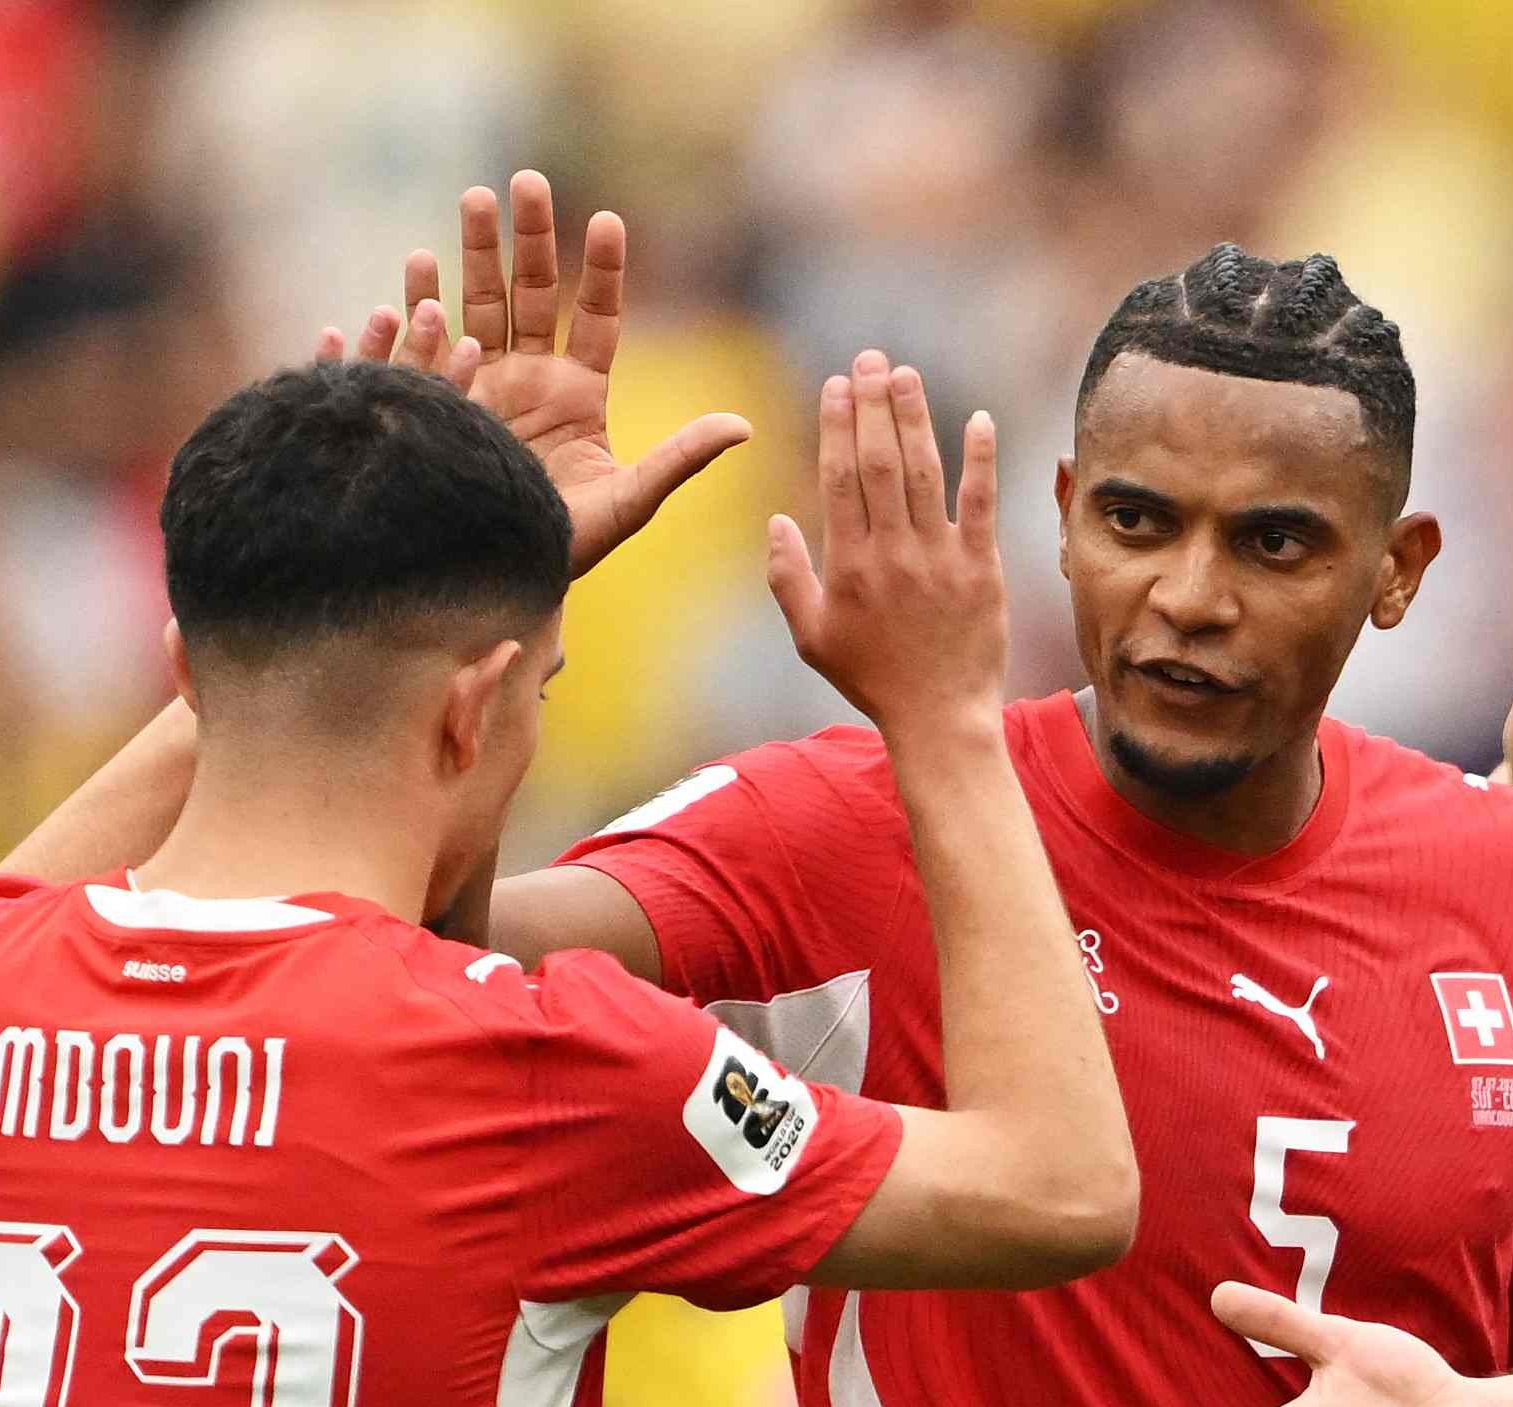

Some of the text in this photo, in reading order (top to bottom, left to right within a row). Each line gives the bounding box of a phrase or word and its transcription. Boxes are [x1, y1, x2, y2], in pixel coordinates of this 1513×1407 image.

[122, 960, 187, 983] suisse
[1470, 1089, 1492, 1109] SUI
[770, 1116, 806, 1172] 2026
[1249, 1115, 1357, 1358] 5
